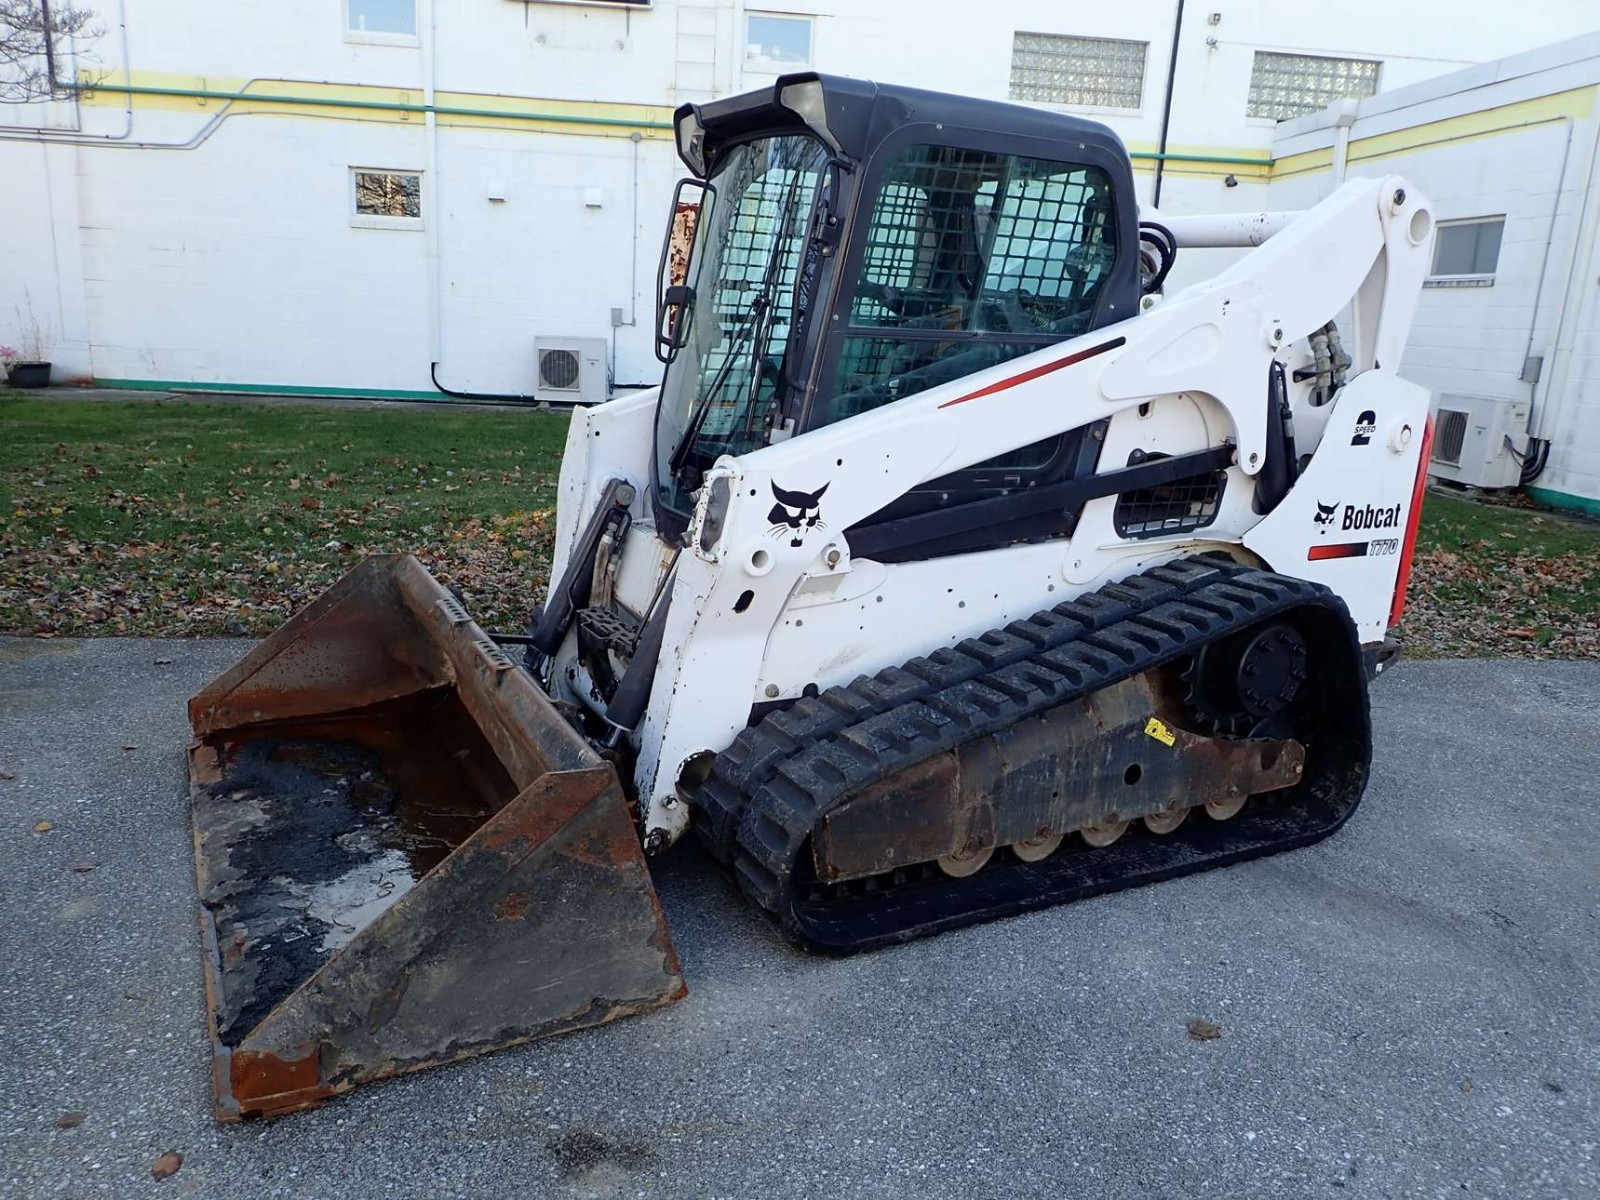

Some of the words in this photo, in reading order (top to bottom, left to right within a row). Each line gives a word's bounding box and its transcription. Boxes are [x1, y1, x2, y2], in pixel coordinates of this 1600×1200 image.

[1350, 410, 1376, 446] 2
[1354, 425, 1376, 434] SPEED
[1342, 503, 1401, 531] Bobcat
[1369, 538, 1399, 556] T770
